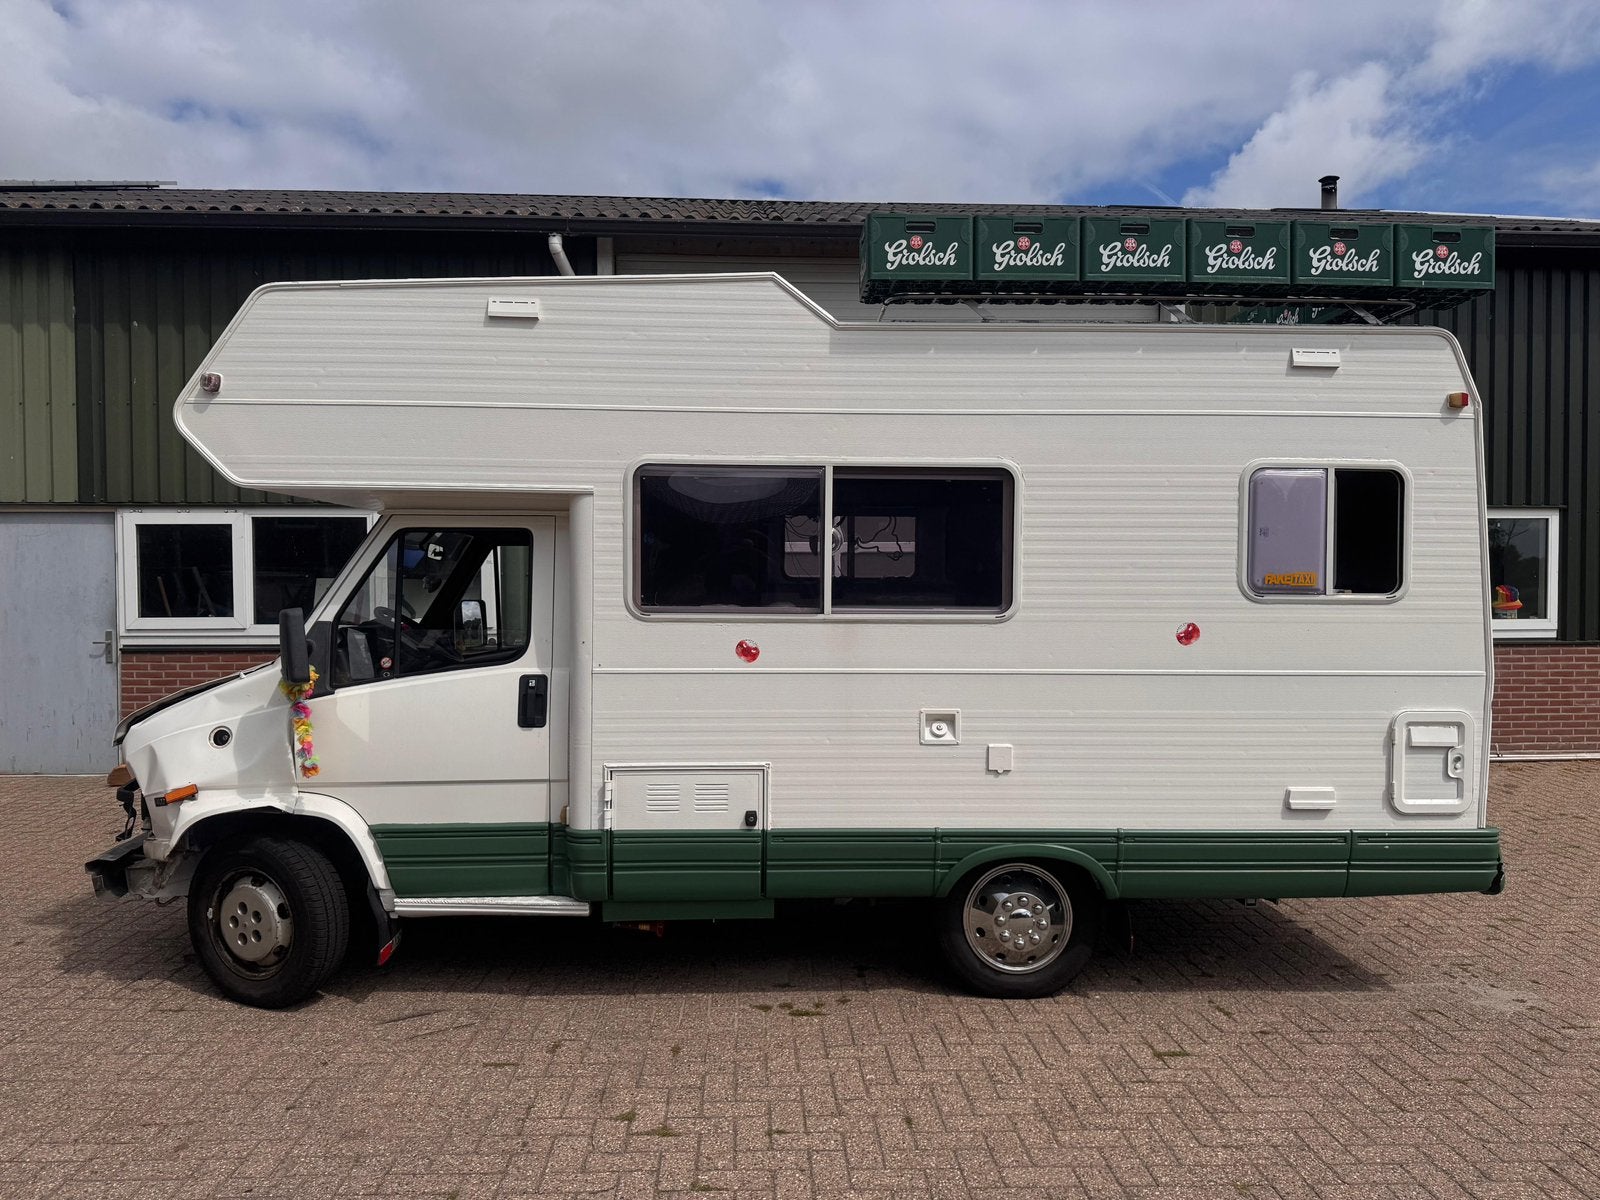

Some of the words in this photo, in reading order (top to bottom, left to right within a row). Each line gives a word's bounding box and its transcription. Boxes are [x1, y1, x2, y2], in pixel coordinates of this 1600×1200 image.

[884, 239, 959, 270] Grolsch
[992, 240, 1065, 271] Grolsch
[1099, 241, 1172, 272] Grolsch
[1205, 243, 1277, 274] Grolsch
[1309, 243, 1380, 275] Grolsch
[1411, 247, 1482, 279] Grolsch
